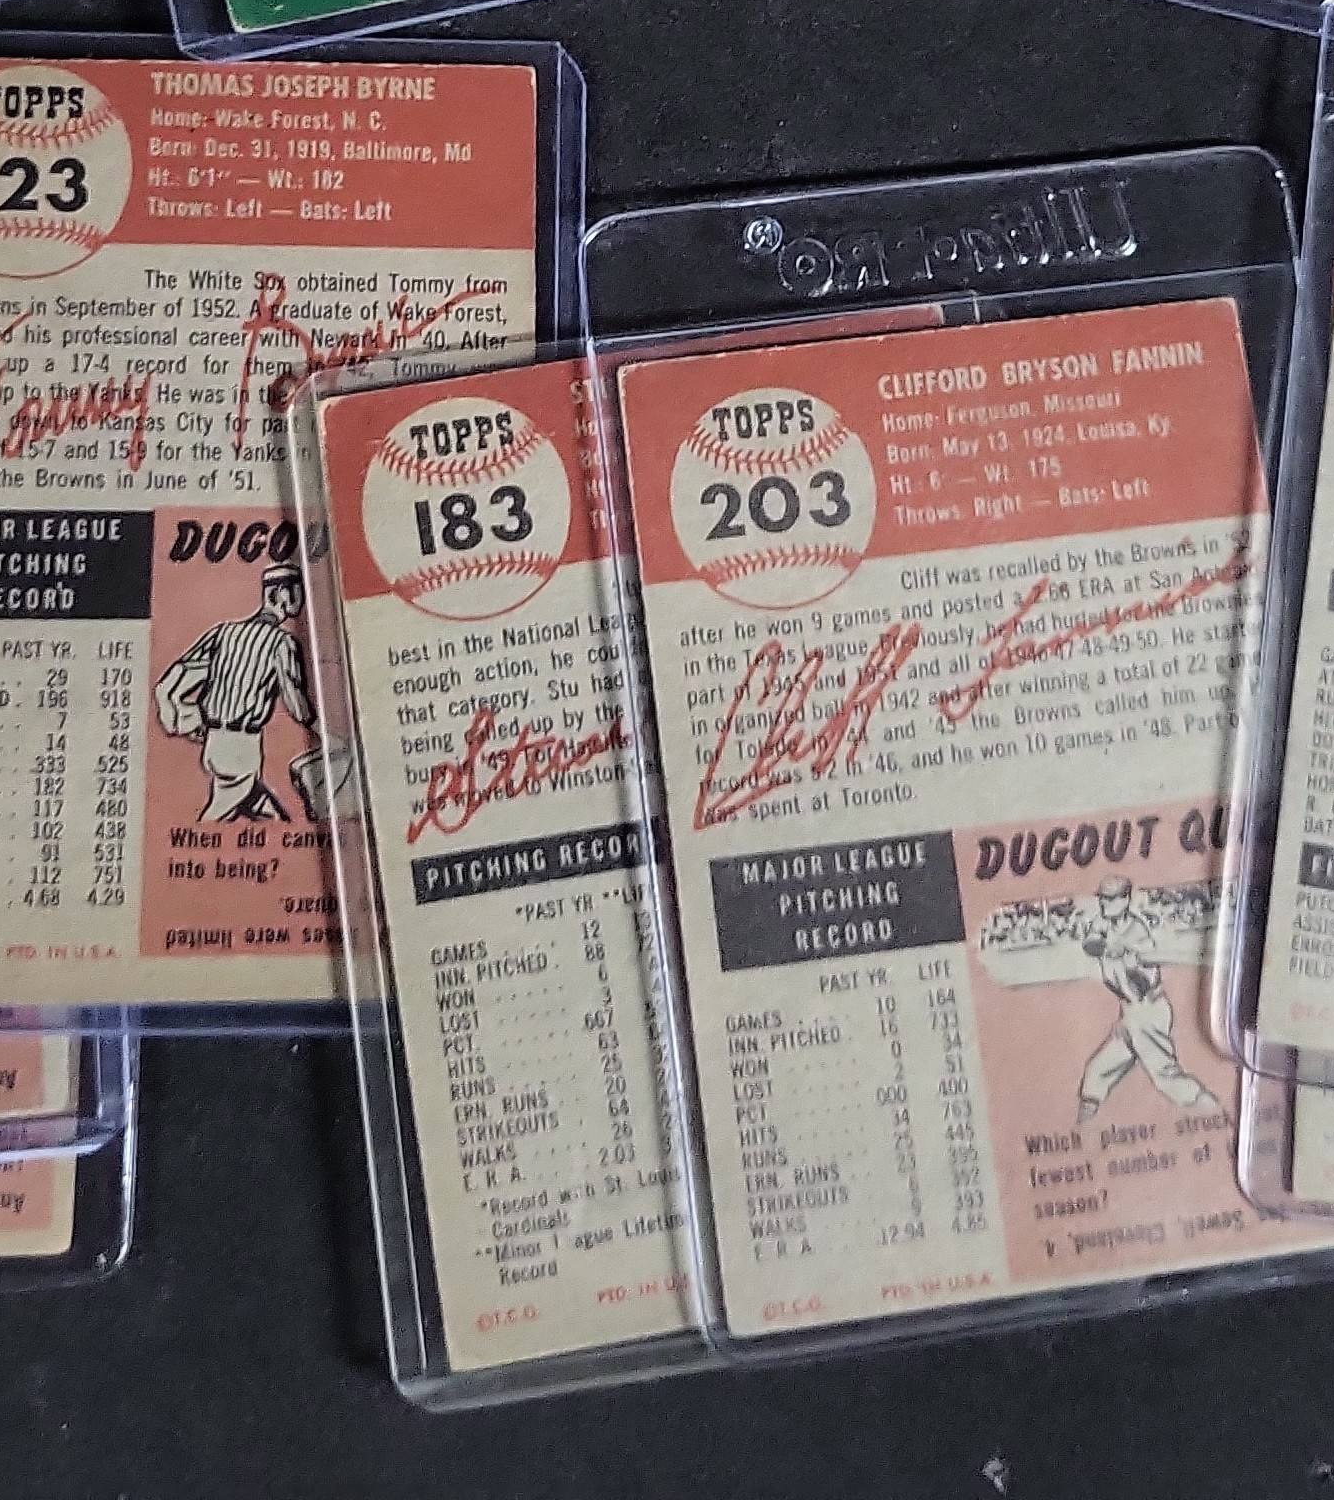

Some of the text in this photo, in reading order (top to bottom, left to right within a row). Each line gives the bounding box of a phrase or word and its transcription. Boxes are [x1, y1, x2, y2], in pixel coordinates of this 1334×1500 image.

[151, 73, 436, 100] THOMAS JOSEPH BYRNE
[150, 109, 335, 132] Home: Wake Forest,
[343, 141, 438, 162] Baltimore,
[144, 271, 455, 299] The White obtained Tommy
[55, 296, 240, 321] September of 1952.
[62, 326, 247, 349] professional career
[878, 340, 1204, 400] CLIFFORD BRYSON FANNIN
[411, 412, 514, 459] TOPPS
[713, 401, 815, 441] TOPPS
[415, 487, 534, 555] 183
[700, 471, 852, 541] 203
[28, 519, 122, 541] LEAGUE
[169, 828, 266, 848] When did
[975, 817, 1155, 880] DUGOUT
[167, 860, 280, 882] into being?
[425, 848, 547, 889] PITCHING
[741, 841, 928, 886] MAJOR LEAGUE
[779, 882, 899, 918] PITCHING
[795, 918, 893, 953] RECORD
